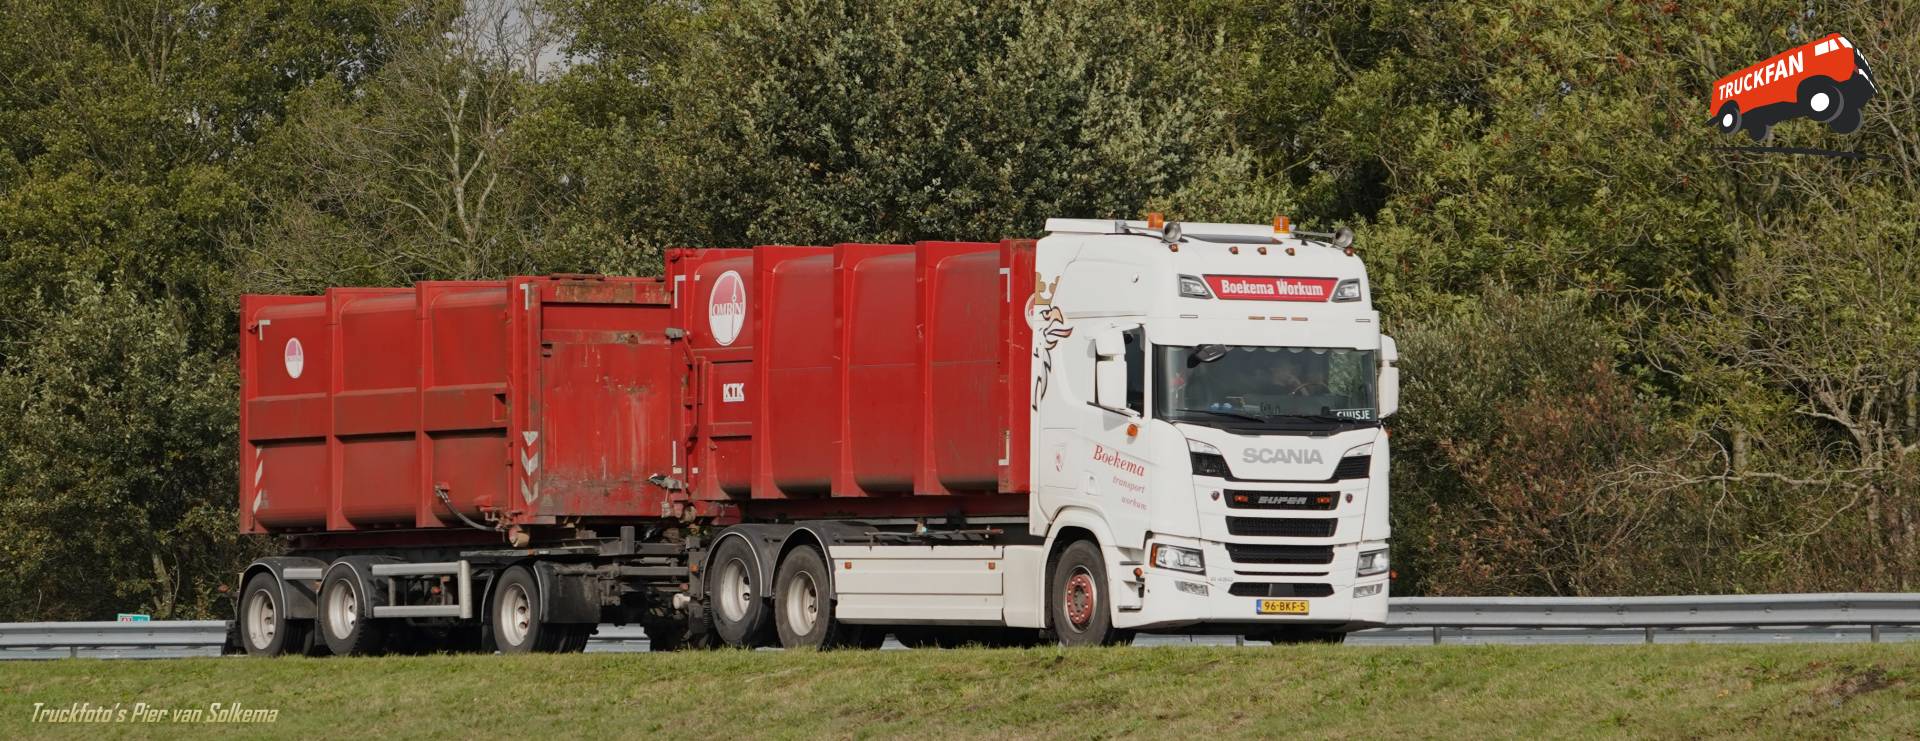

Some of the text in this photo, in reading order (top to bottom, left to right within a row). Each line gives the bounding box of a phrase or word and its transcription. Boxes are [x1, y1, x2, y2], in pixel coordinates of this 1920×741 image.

[1221, 280, 1324, 296] Boekema Workum
[723, 383, 745, 402] KTK
[1093, 444, 1145, 477] Boekema
[1242, 447, 1324, 465] SCANIA
[1112, 475, 1145, 494] transport
[1257, 495, 1308, 505] SUPER
[1264, 601, 1306, 611] 96-BKF-5
